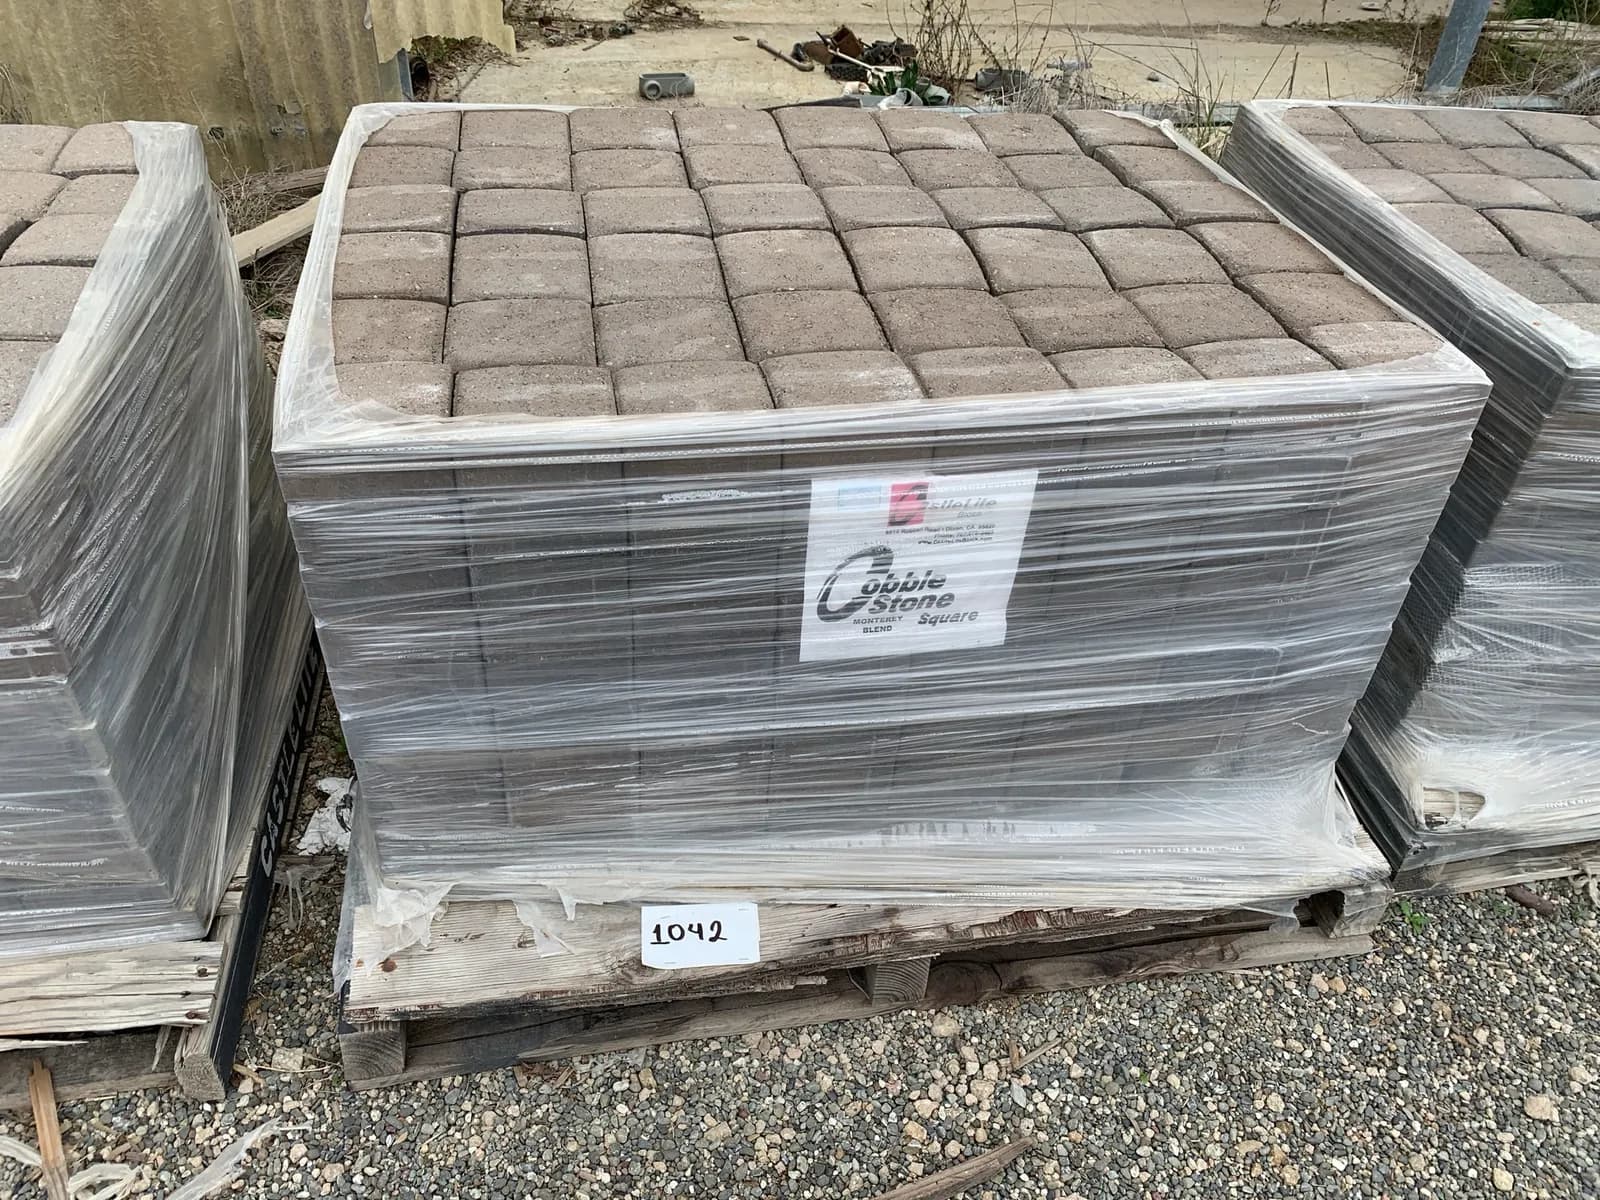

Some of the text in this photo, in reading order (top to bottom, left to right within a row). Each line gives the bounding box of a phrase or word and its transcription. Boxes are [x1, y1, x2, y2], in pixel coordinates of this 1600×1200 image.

[817, 545, 947, 622] Cobble
[868, 592, 955, 614] Stone
[853, 616, 903, 625] MONTEREY
[917, 610, 979, 627] Square
[862, 625, 893, 634] BLEND
[650, 920, 728, 944] 1042
